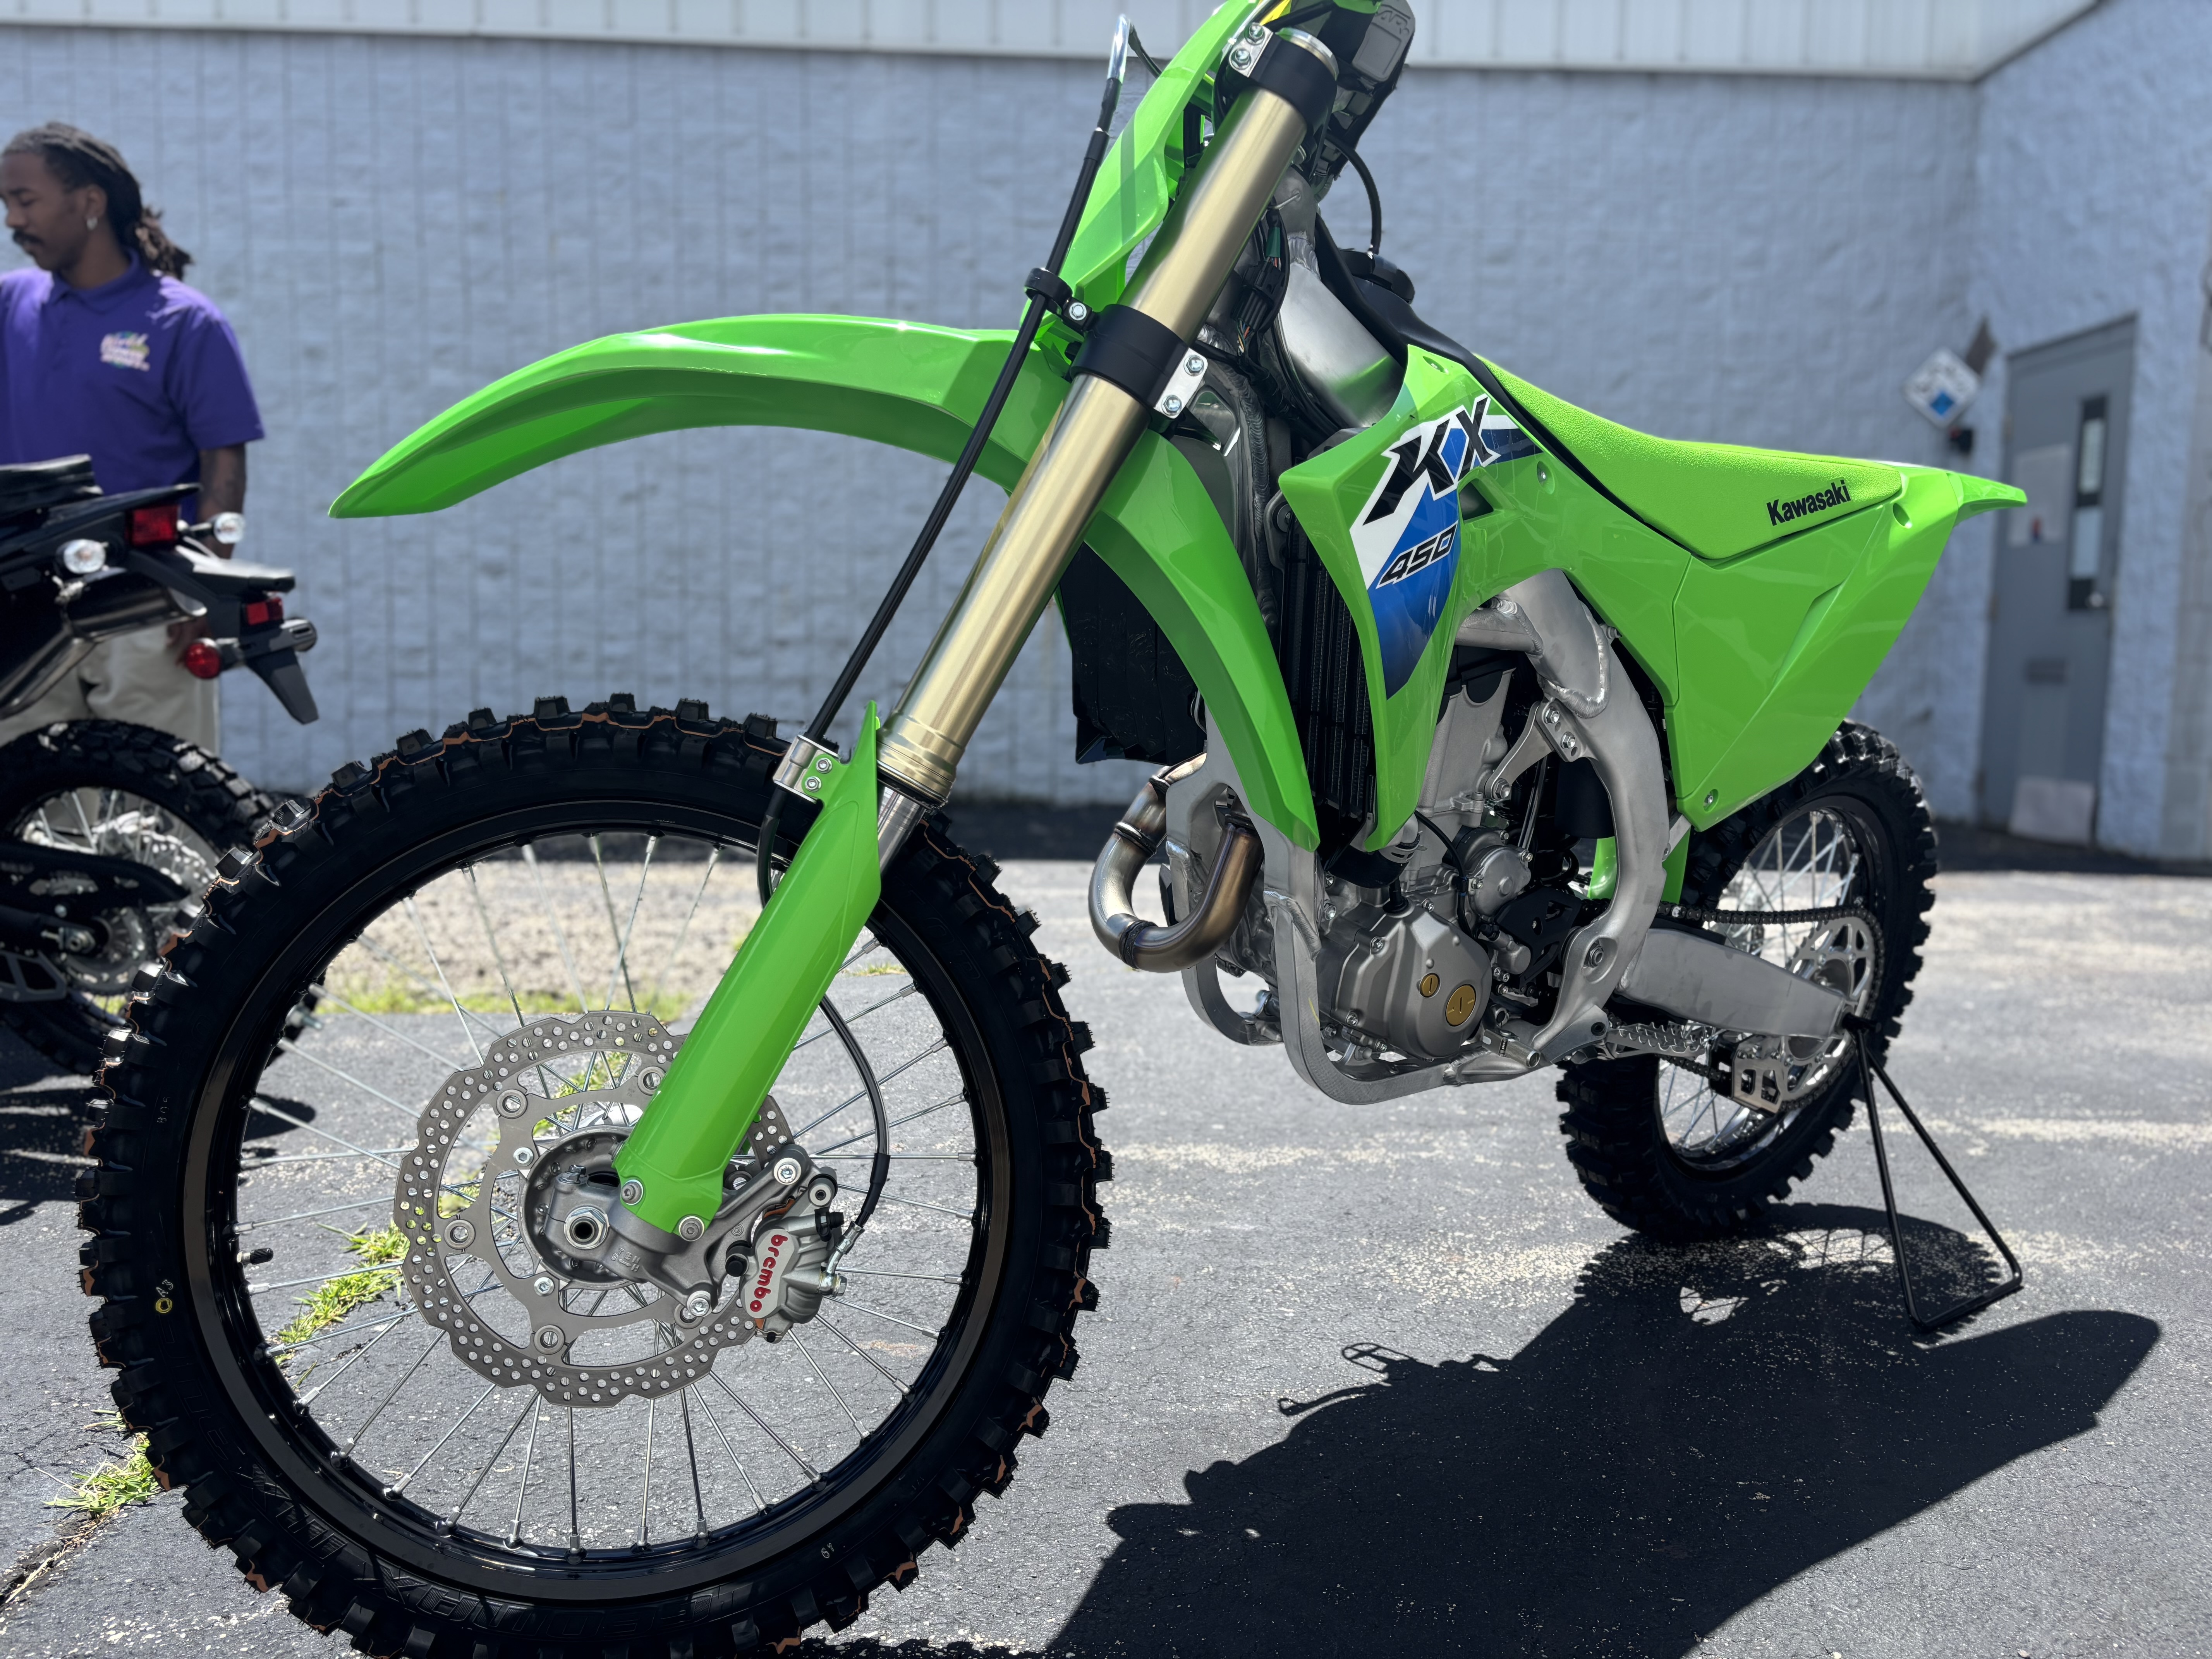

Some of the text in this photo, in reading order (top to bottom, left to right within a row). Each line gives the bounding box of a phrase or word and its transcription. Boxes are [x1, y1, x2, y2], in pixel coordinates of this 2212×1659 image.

[1362, 396, 1494, 526] KX
[1766, 479, 1851, 526] Kawasaki
[1379, 523, 1458, 586] 450
[618, 1247, 641, 1265] TEN
[750, 1234, 788, 1312] brembo
